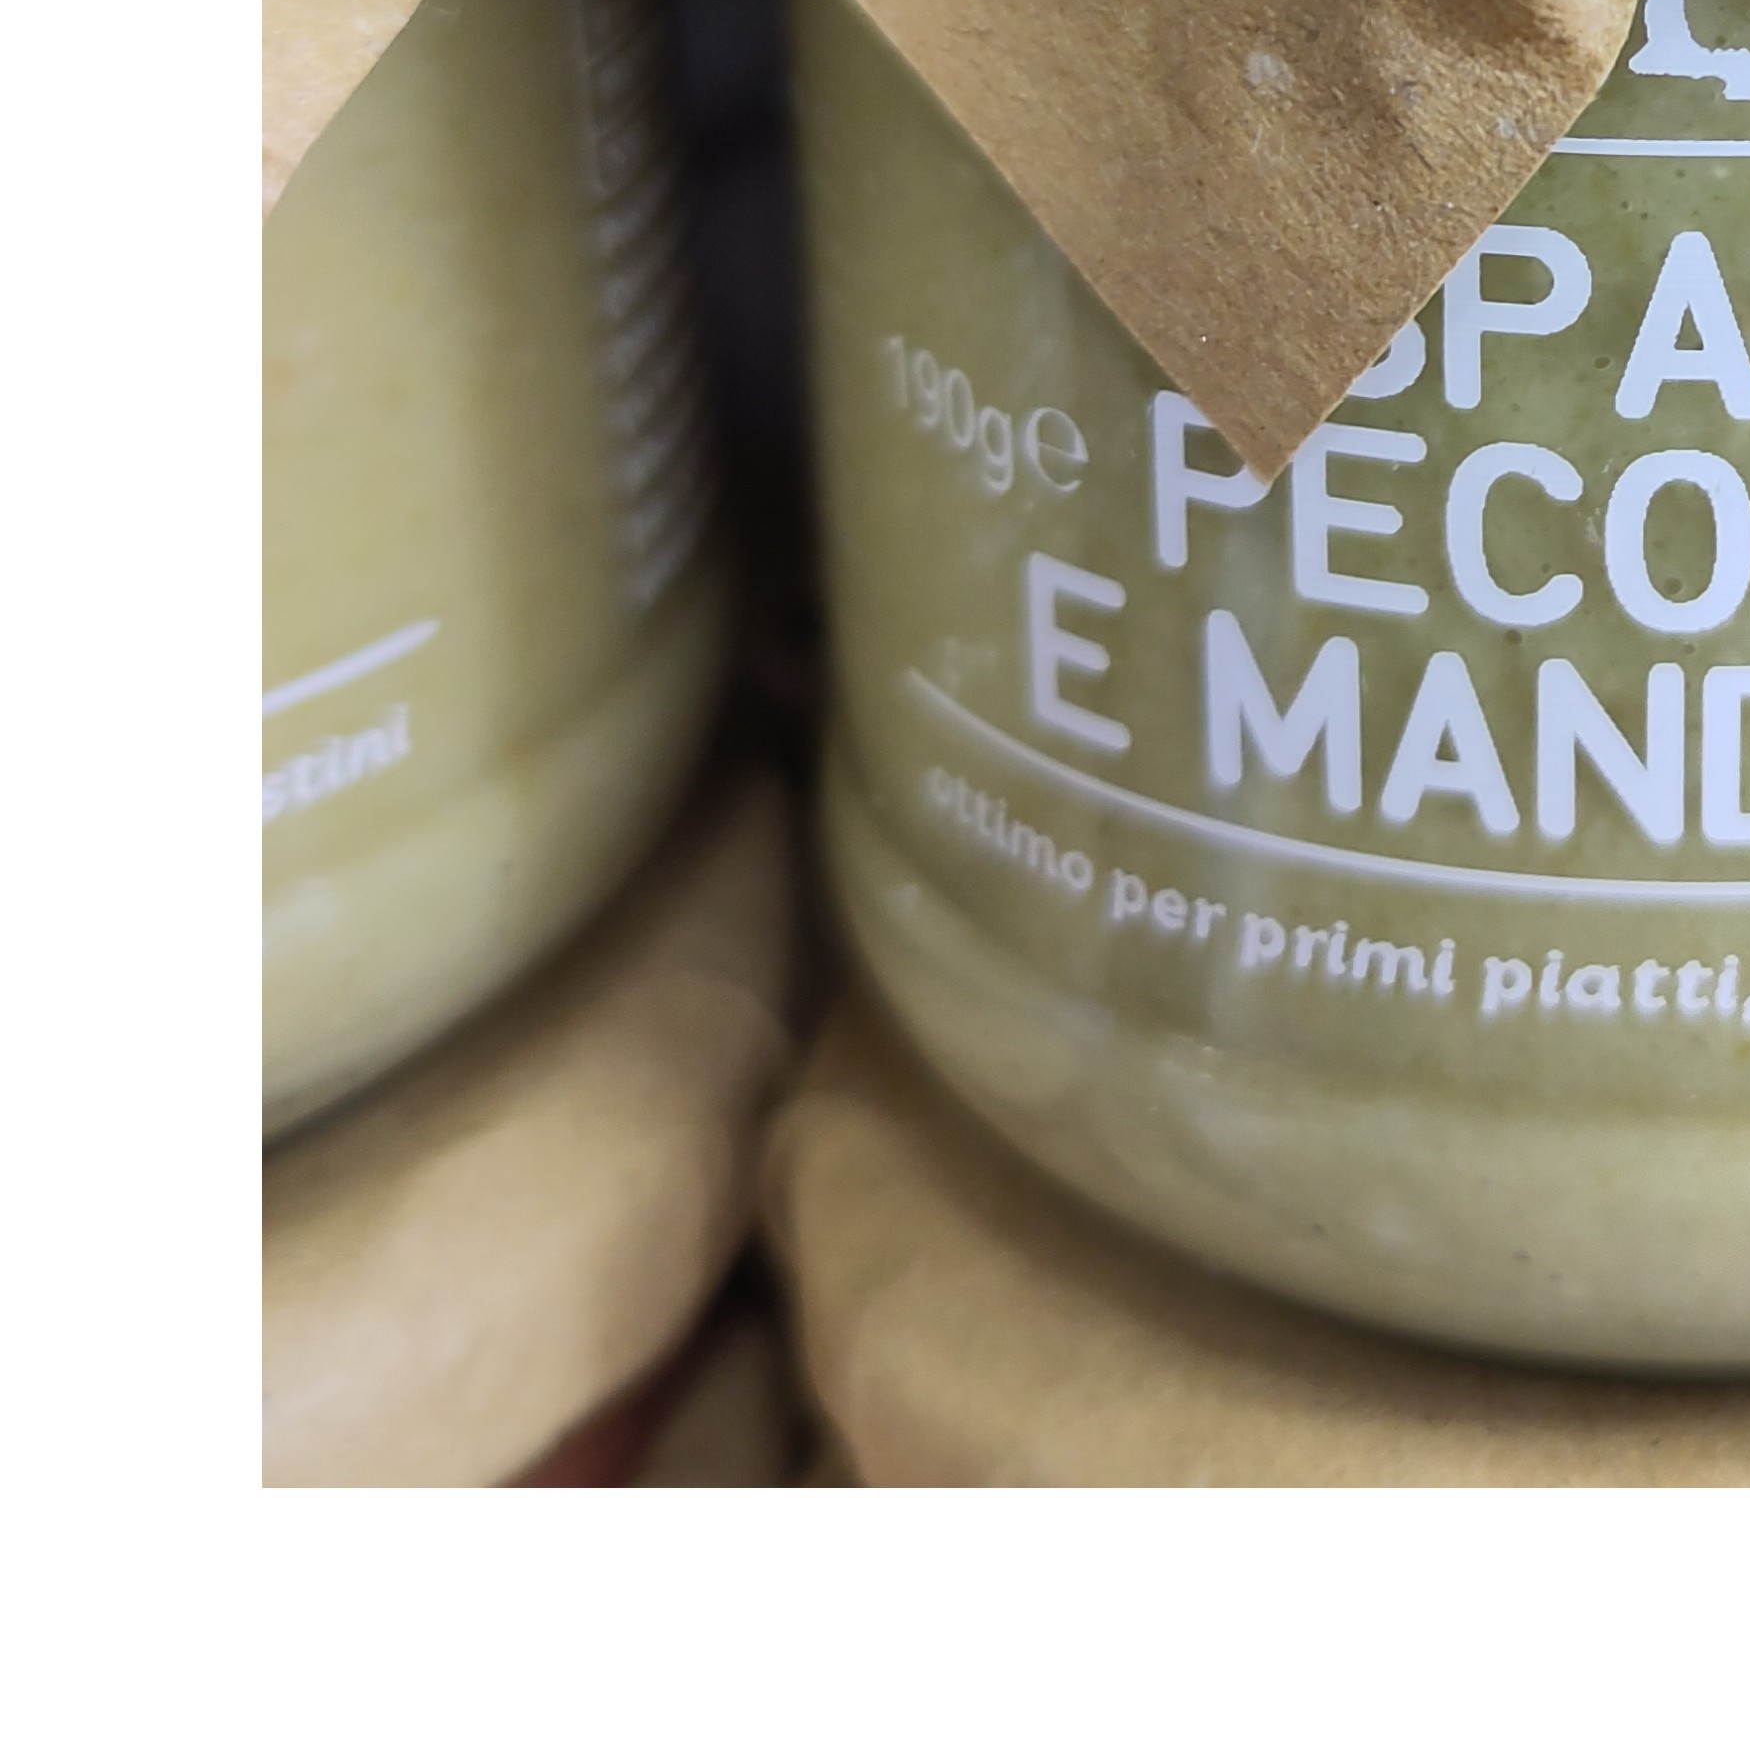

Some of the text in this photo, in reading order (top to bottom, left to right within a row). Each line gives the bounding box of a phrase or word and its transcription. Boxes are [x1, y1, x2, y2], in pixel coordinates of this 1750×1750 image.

[1027, 550, 1133, 754] E
[923, 764, 1097, 892] ottimo
[1110, 863, 1230, 942] per
[1240, 906, 1460, 998] primi
